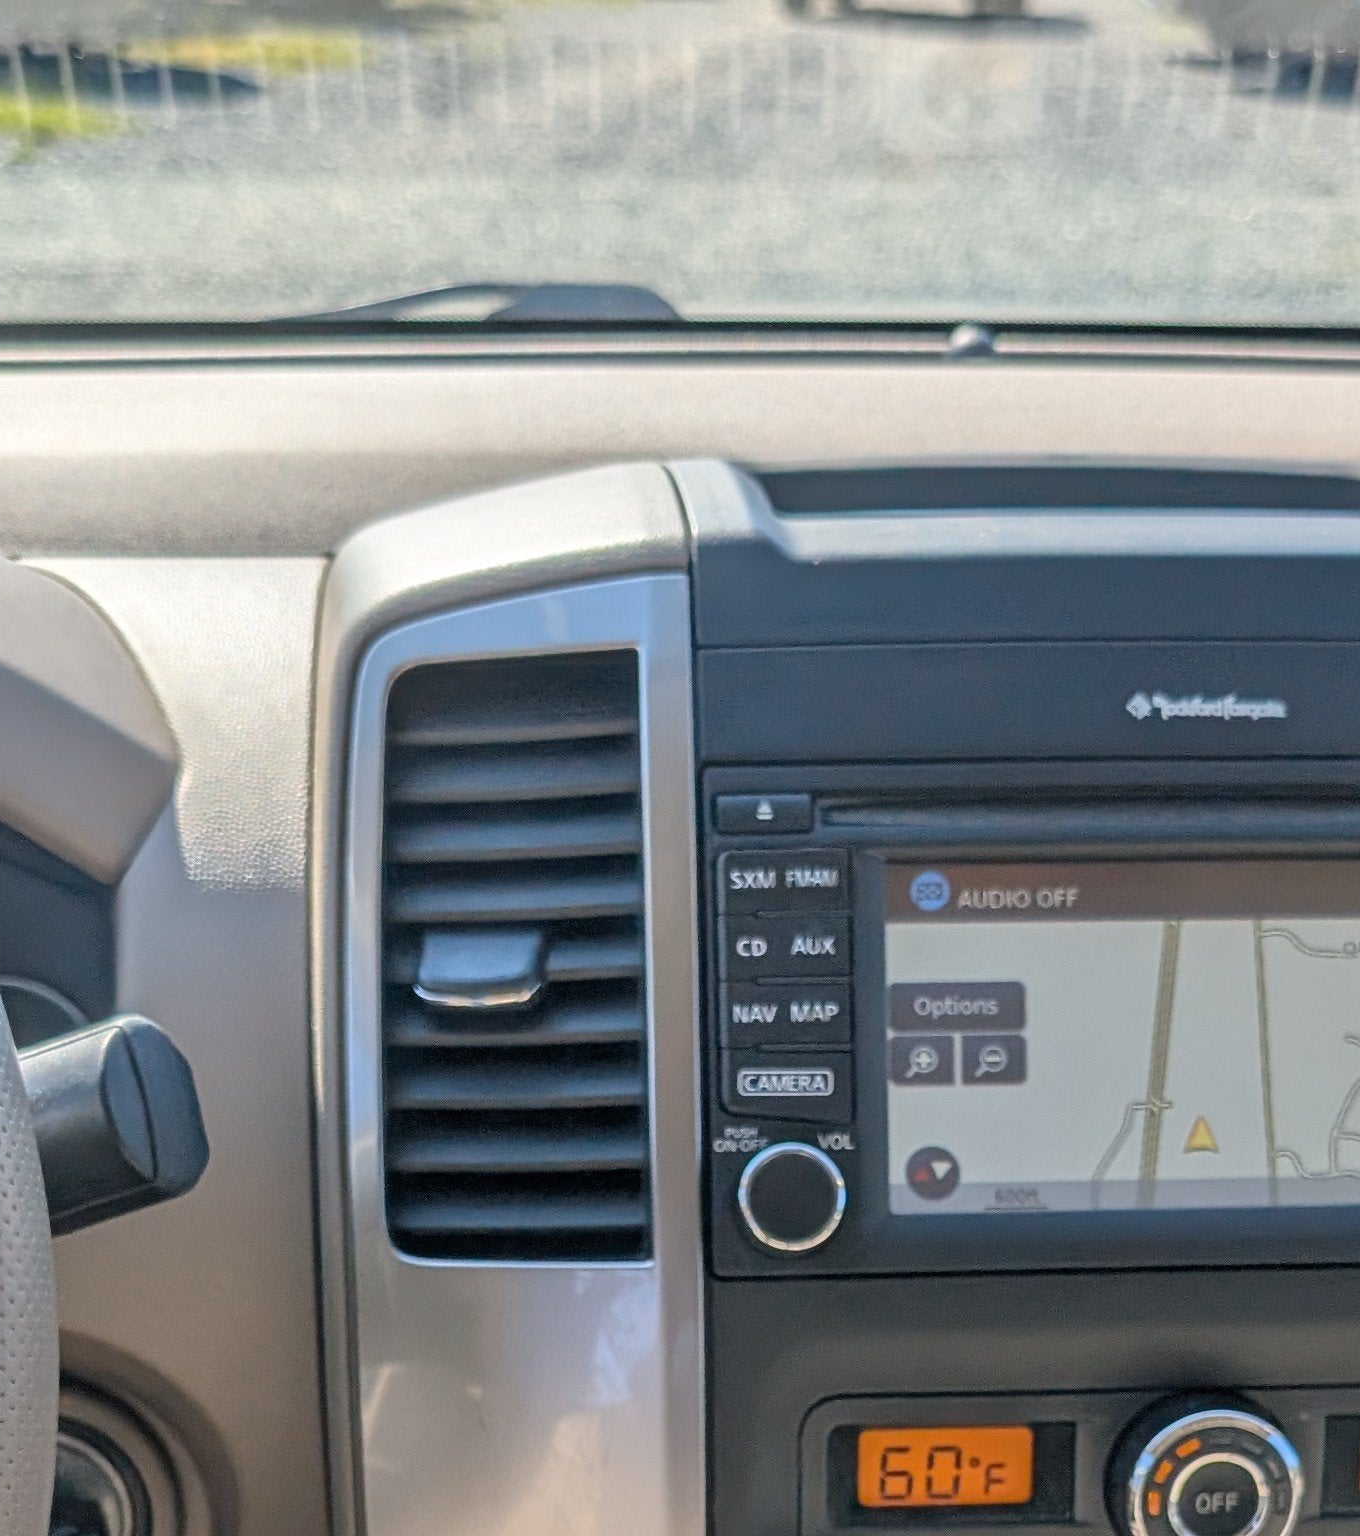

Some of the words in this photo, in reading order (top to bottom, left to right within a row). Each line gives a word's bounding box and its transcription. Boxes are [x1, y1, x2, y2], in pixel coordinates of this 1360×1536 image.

[730, 870, 776, 889] SXM
[957, 888, 1032, 909] AUDIO
[1036, 887, 1080, 909] OFF
[736, 936, 768, 957] CD
[791, 936, 836, 956] AUX
[732, 1004, 778, 1023] NAV
[790, 1003, 840, 1023] MAP
[914, 996, 1000, 1019] Options
[743, 1074, 828, 1092] CAMERA
[817, 1132, 855, 1151] VOL
[1195, 1490, 1239, 1515] OFF
